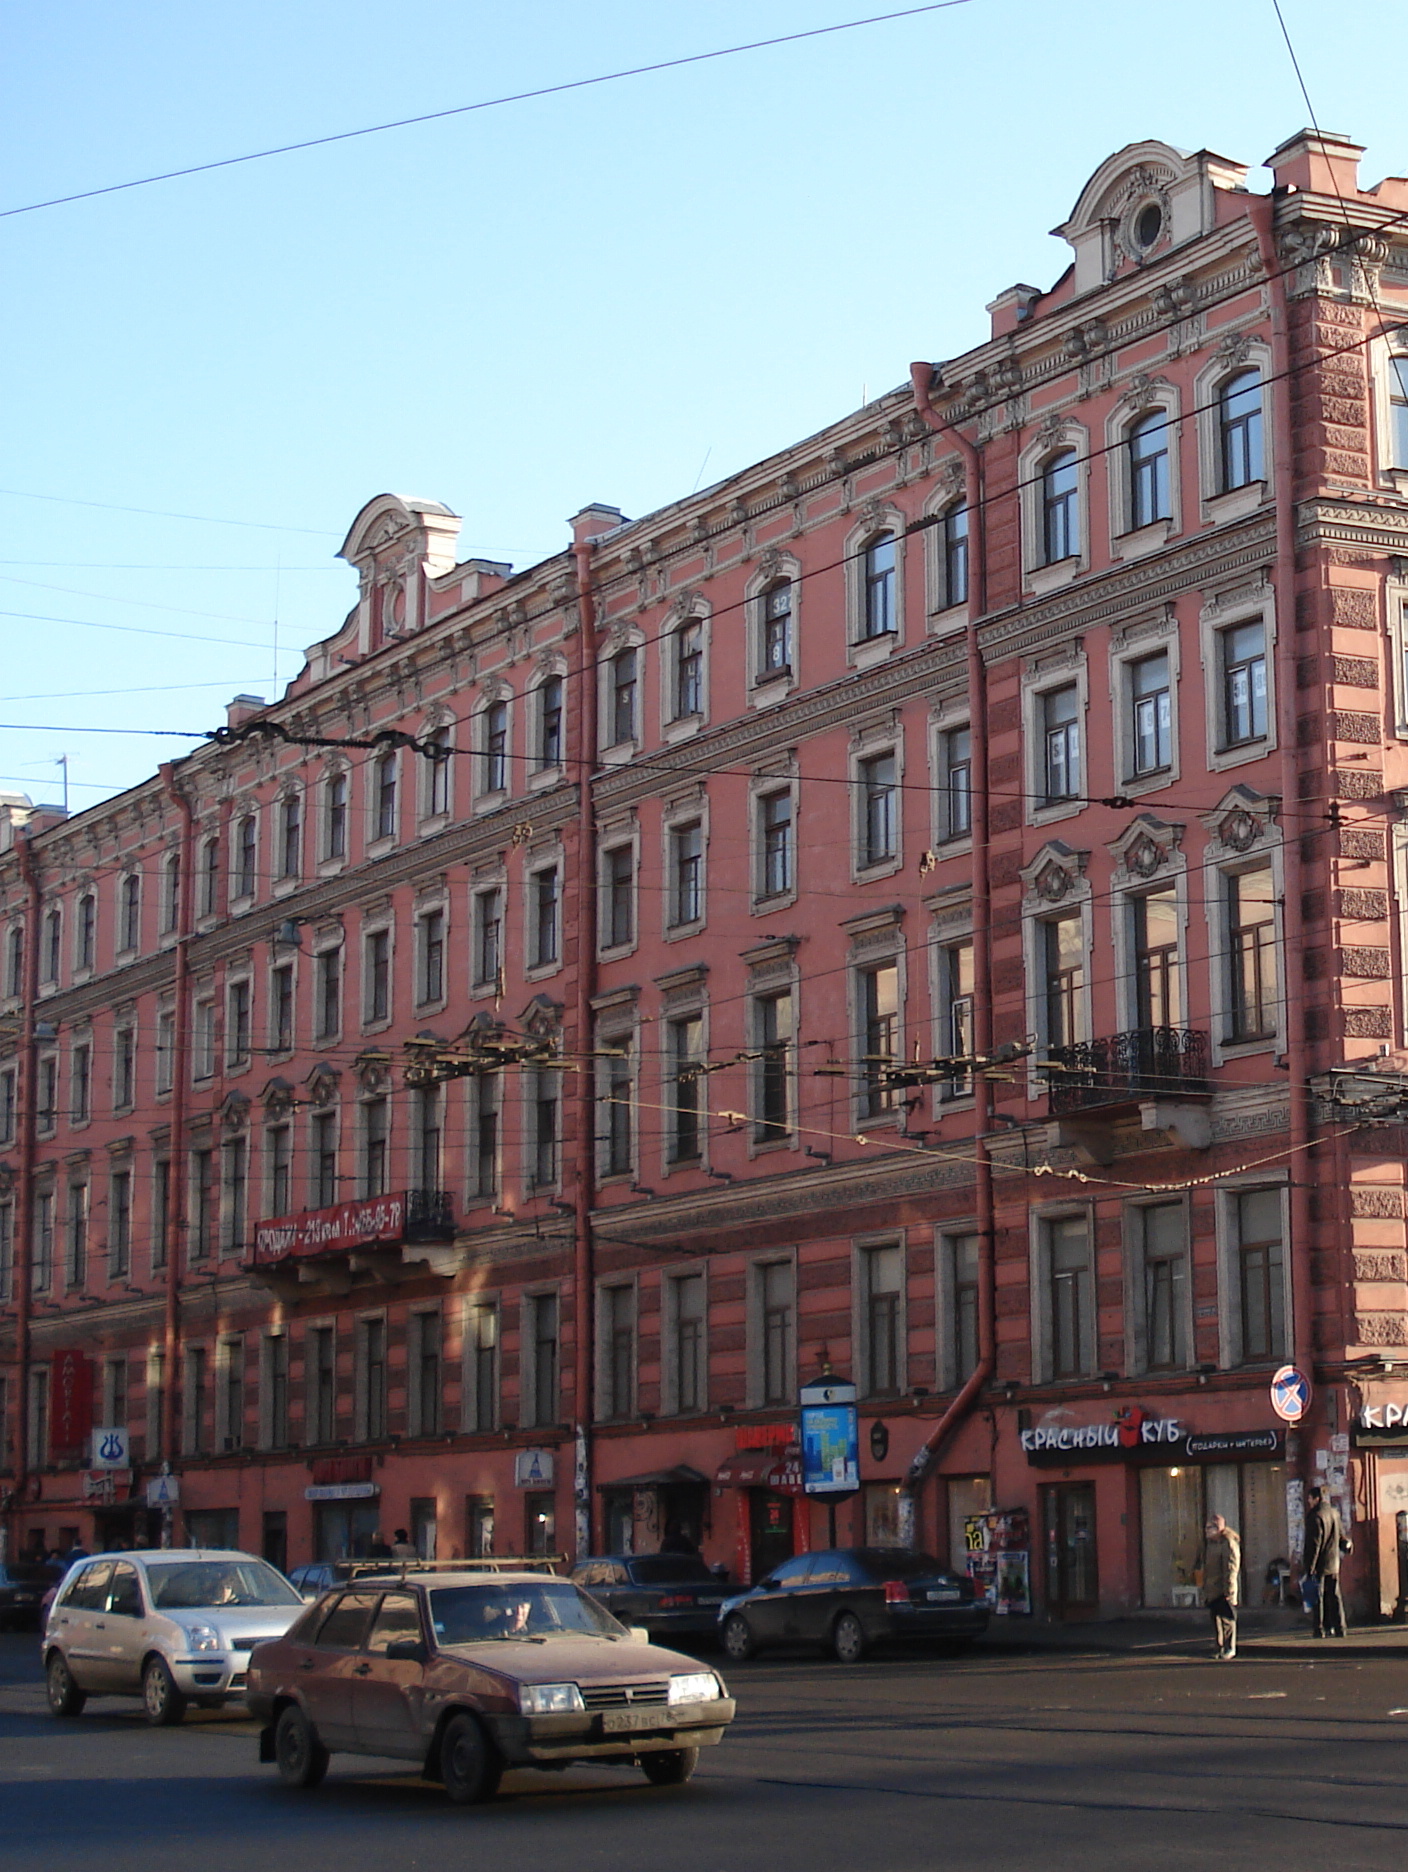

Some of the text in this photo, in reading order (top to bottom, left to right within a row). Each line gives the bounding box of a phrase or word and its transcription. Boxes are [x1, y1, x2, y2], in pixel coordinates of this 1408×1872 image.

[1021, 1419, 1180, 1451] КРАСНЫЙ КУБ
[769, 1474, 802, 1486] ШАВЕ
